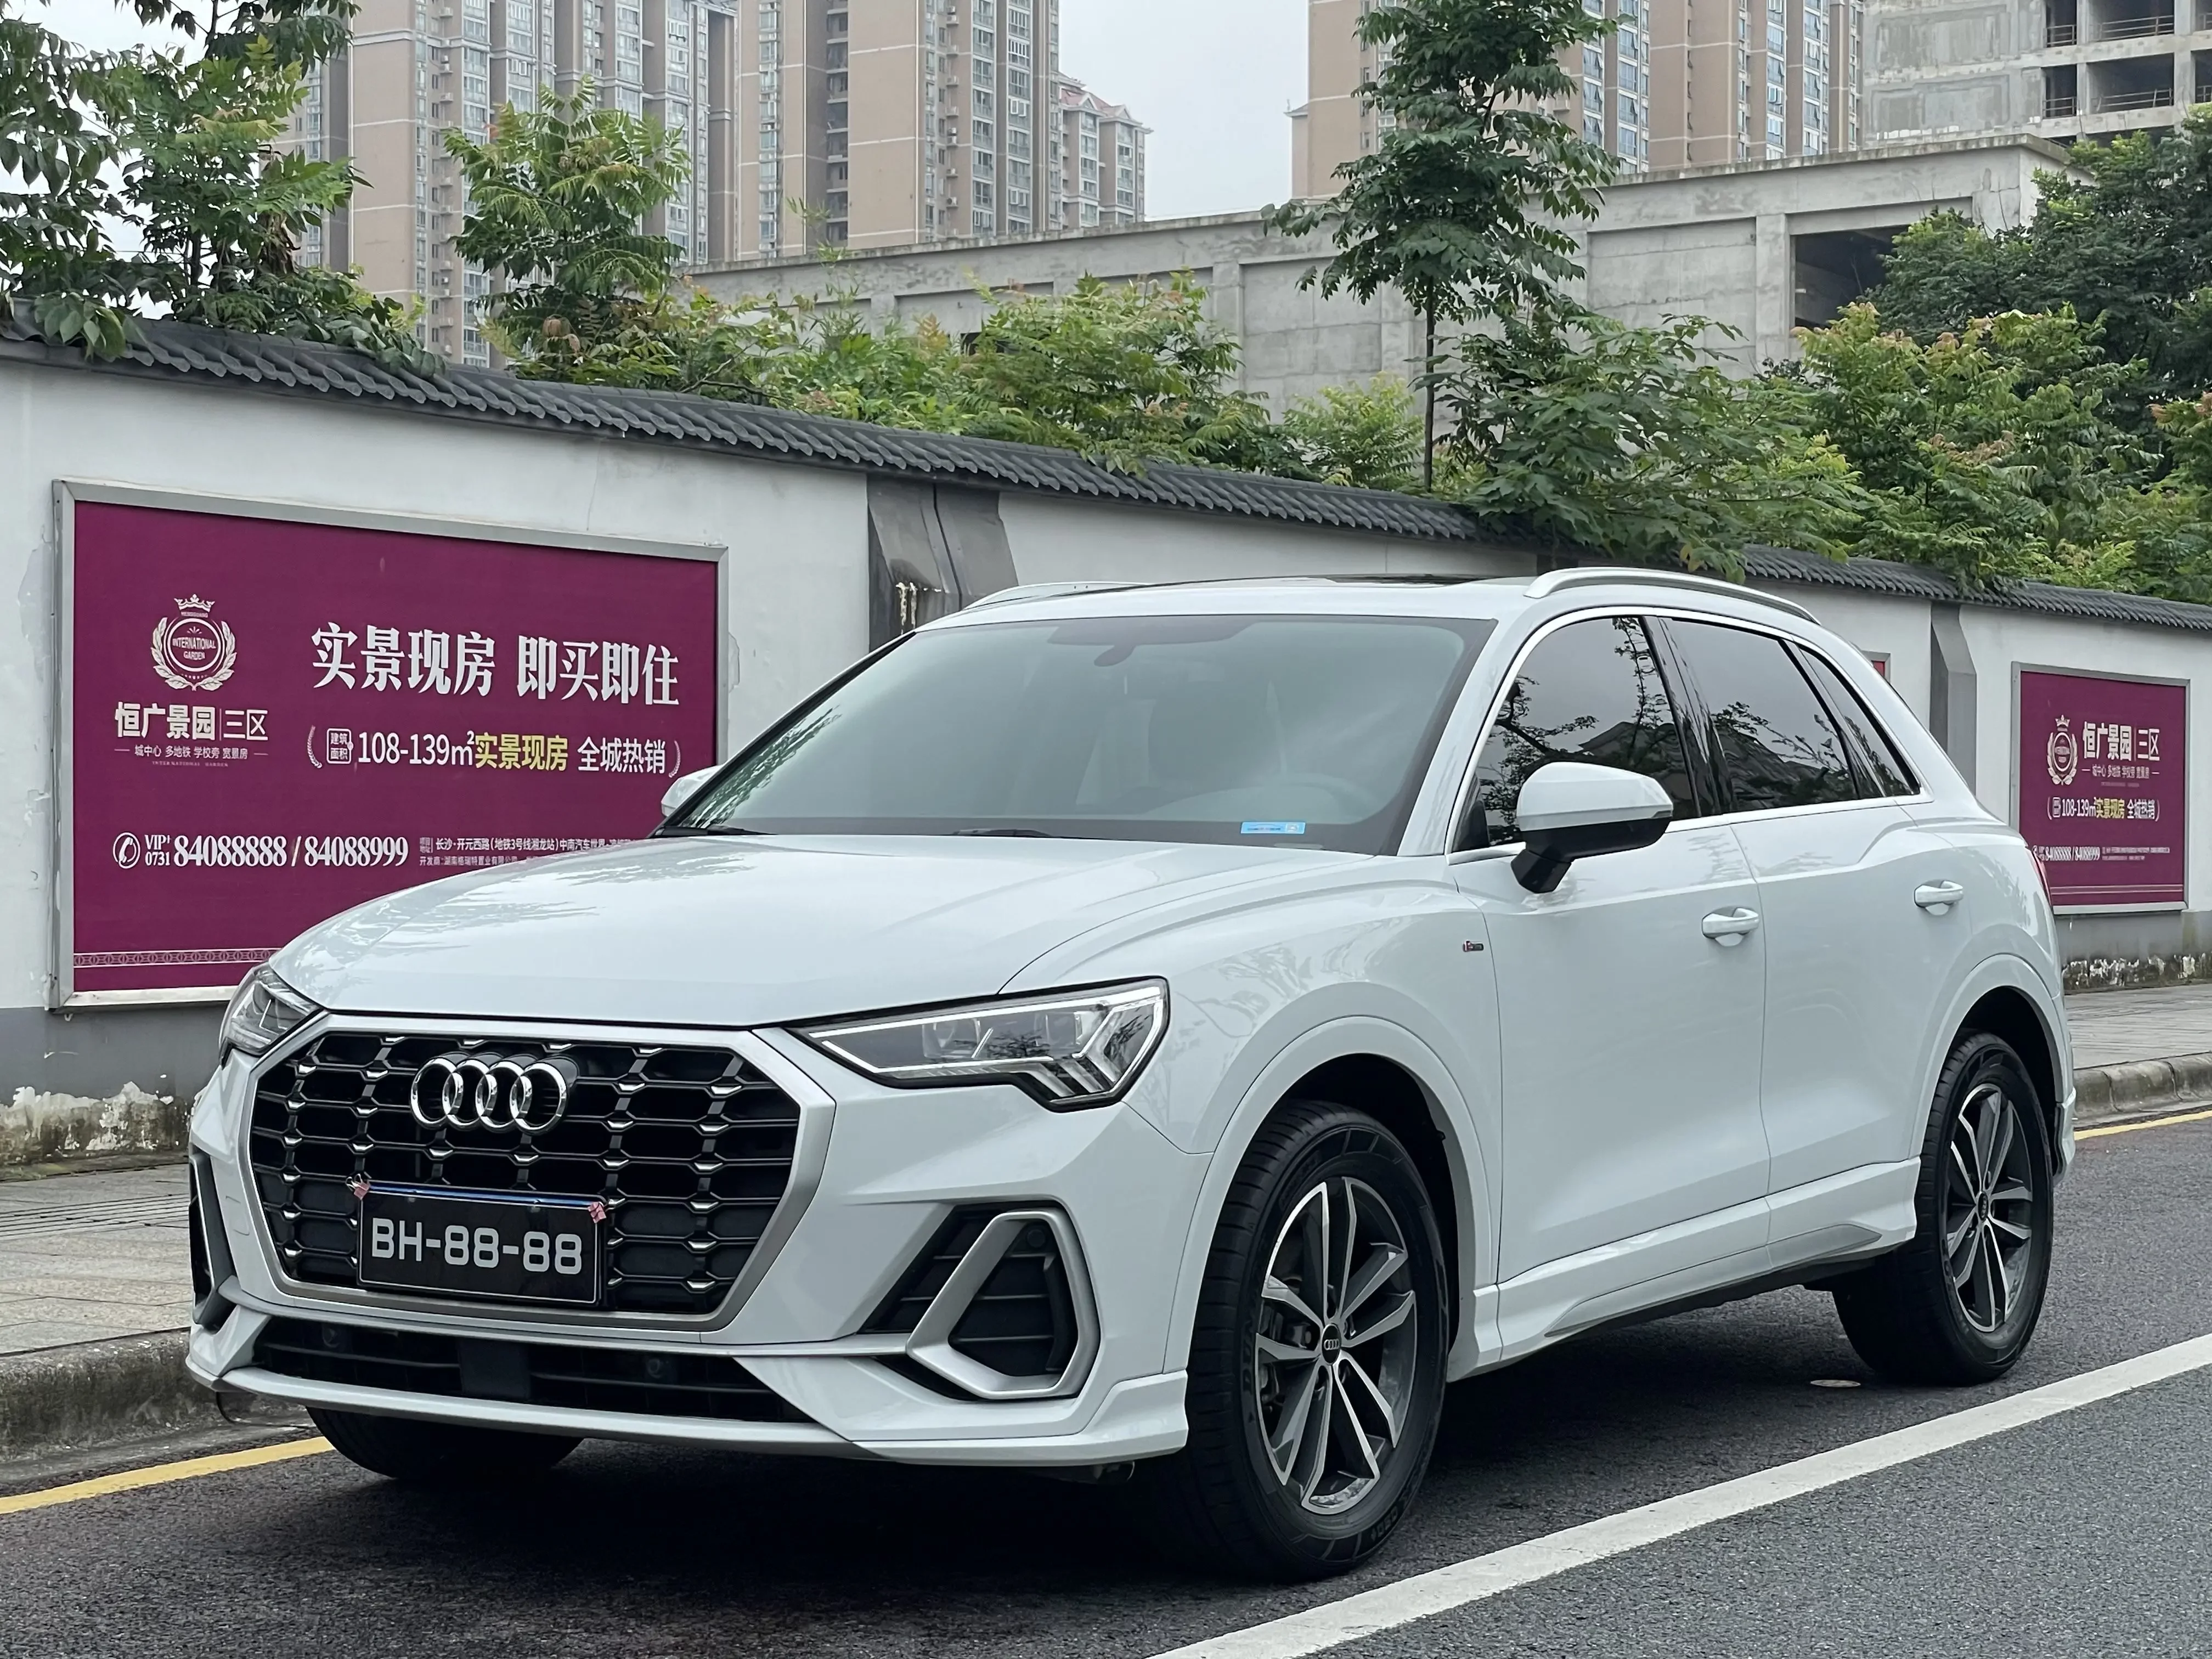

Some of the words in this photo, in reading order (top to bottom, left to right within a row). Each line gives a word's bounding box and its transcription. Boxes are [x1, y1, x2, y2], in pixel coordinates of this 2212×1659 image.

[173, 637, 216, 650] INTERNATIONAL
[312, 622, 495, 696] 实景现房
[517, 635, 679, 704] 即买即住
[115, 702, 215, 740] 恒广景园
[224, 709, 268, 740] 三区
[135, 744, 161, 757] 城中心
[165, 746, 190, 758] 多地铁
[194, 746, 219, 759] 学校旁
[578, 737, 665, 774] 全城热销
[2083, 721, 2131, 761] 恒广景园
[2137, 729, 2159, 760] 三区
[145, 851, 170, 865] 0731
[372, 1218, 582, 1274] BH-88-88
